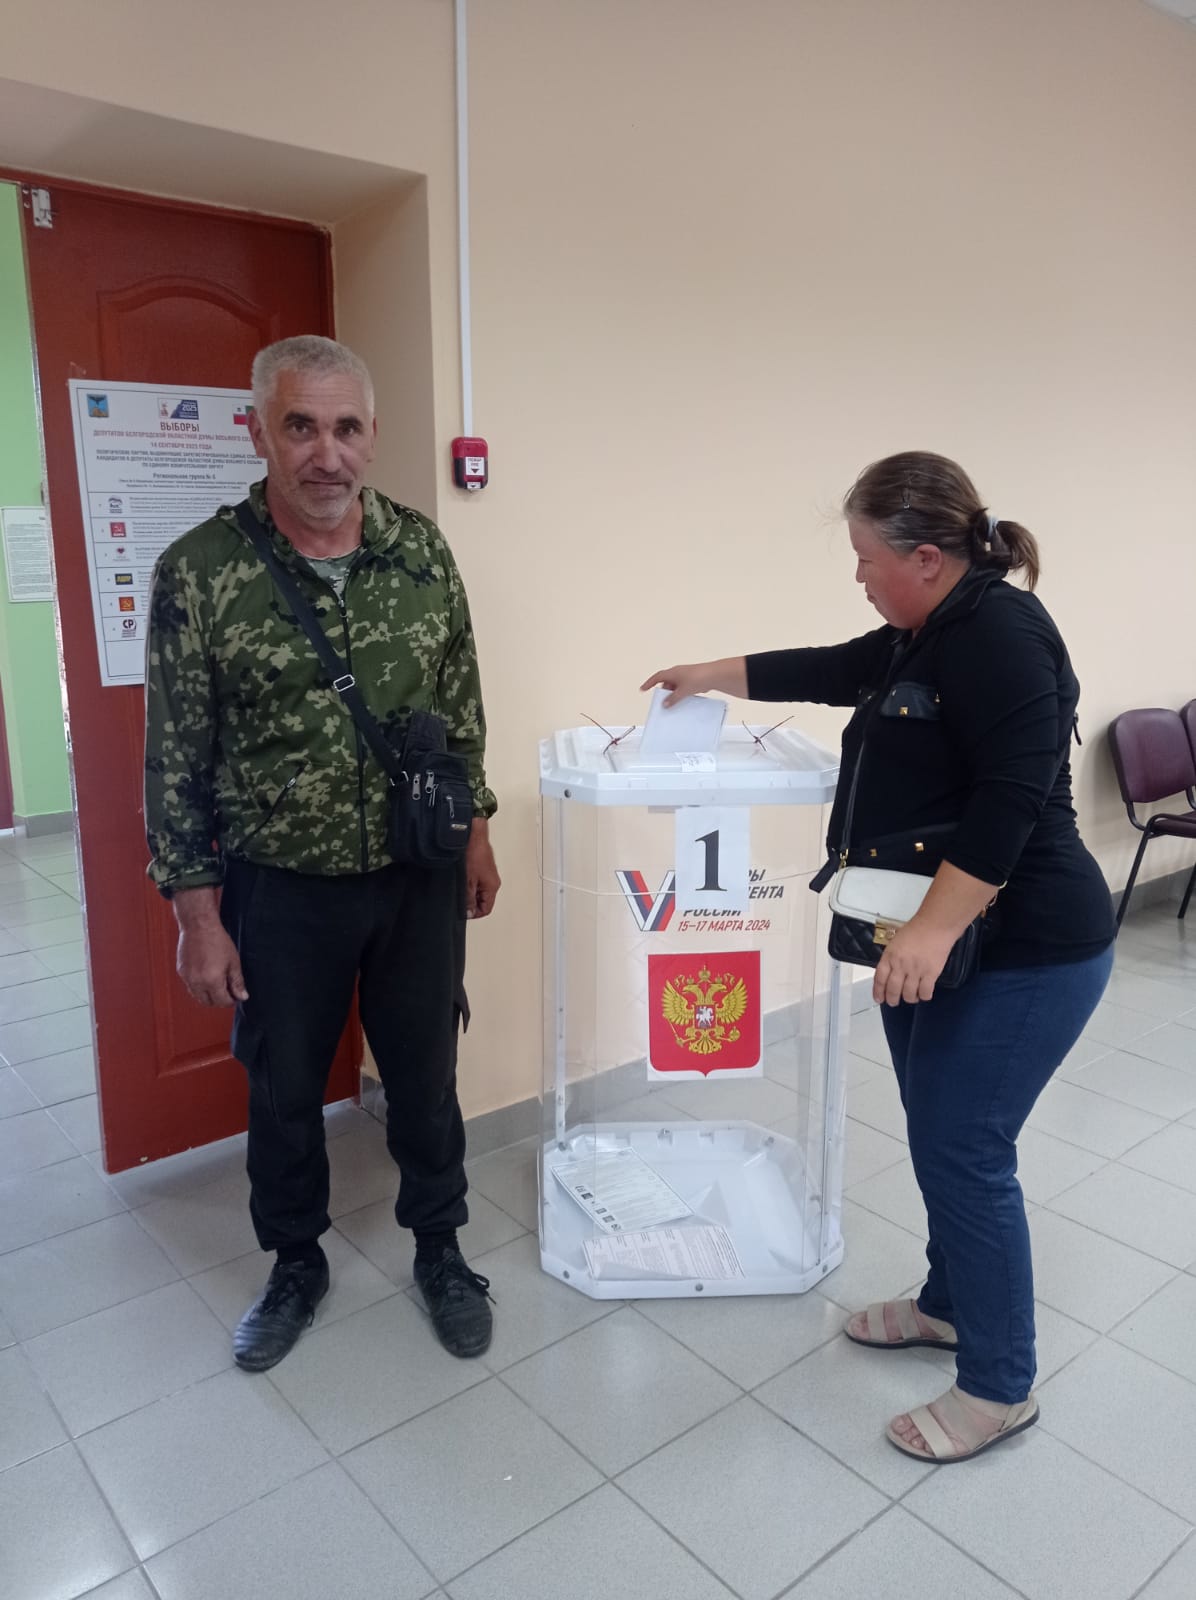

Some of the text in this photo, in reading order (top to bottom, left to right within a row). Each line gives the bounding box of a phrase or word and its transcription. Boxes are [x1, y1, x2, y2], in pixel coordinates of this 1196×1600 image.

[160, 422, 200, 432] ВЫБОРЫ
[694, 829, 728, 892] 1
[707, 920, 744, 931] МАРТА
[745, 919, 771, 931] 2024
